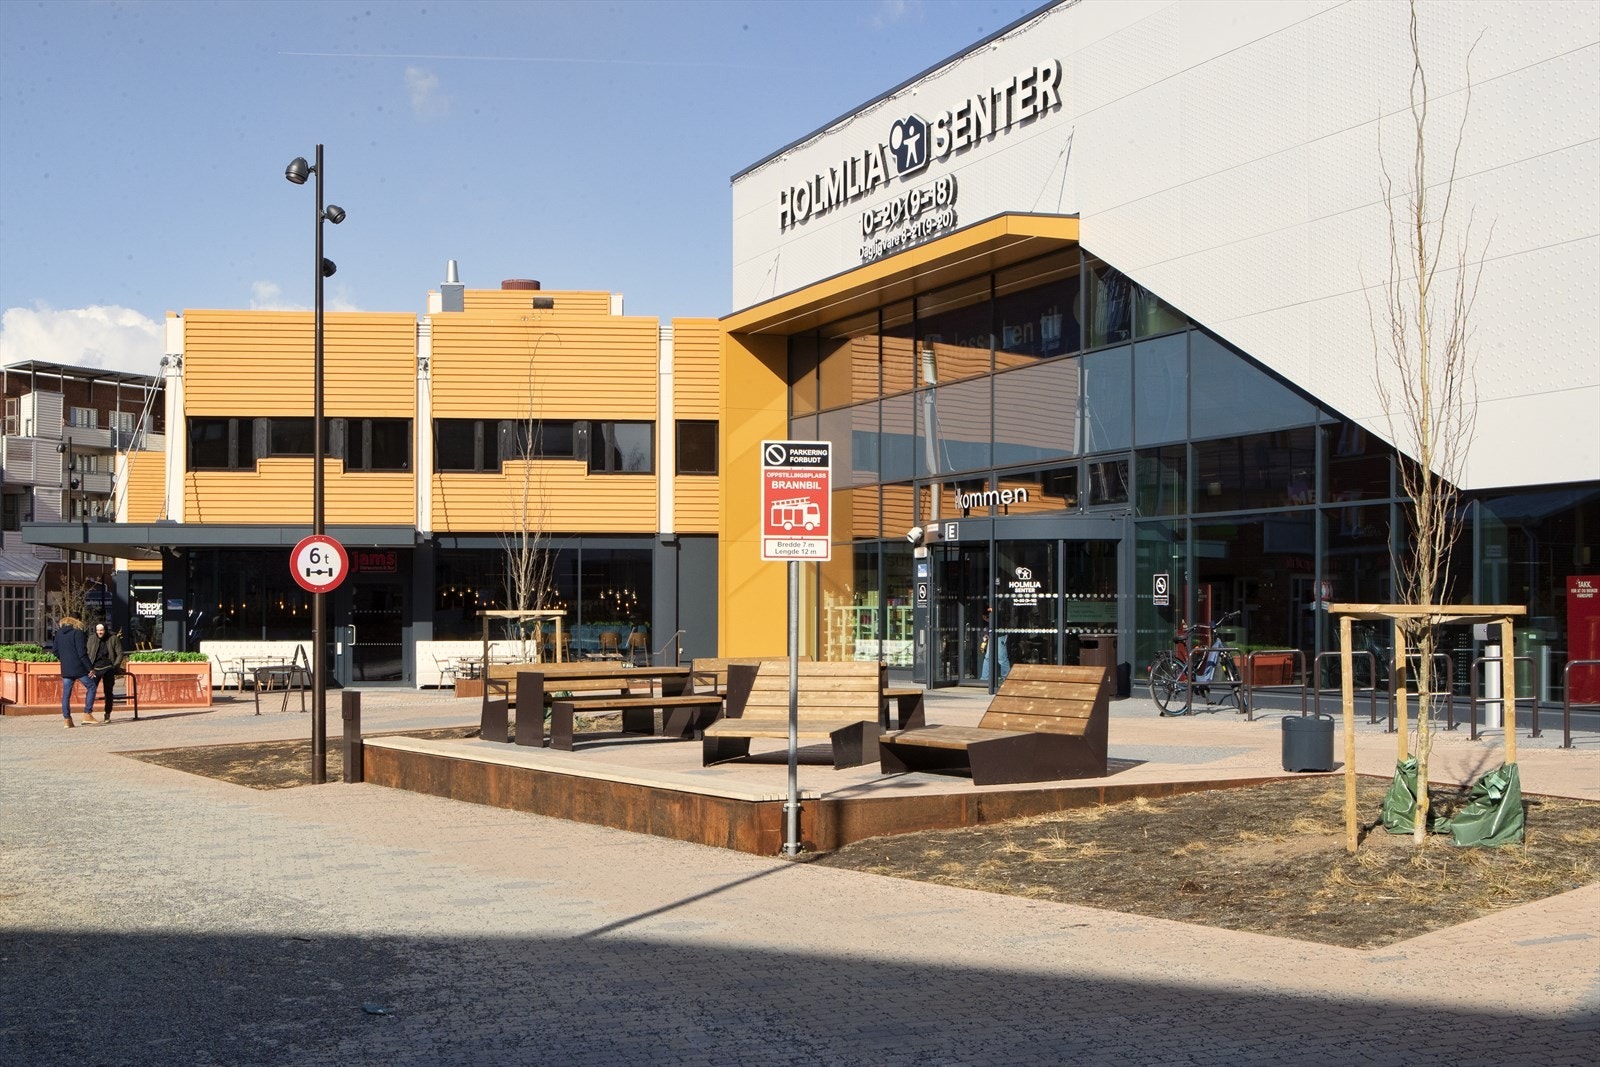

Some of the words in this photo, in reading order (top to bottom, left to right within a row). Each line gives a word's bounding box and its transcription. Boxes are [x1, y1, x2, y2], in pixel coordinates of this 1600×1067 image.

[778, 143, 888, 230] HOLMLIA
[931, 58, 1061, 158] SENTER
[771, 480, 822, 490] BRANNBIL
[948, 525, 955, 538] E
[309, 547, 321, 564] 6
[324, 554, 329, 564] t
[136, 601, 162, 610] happy
[136, 608, 163, 616] homes
